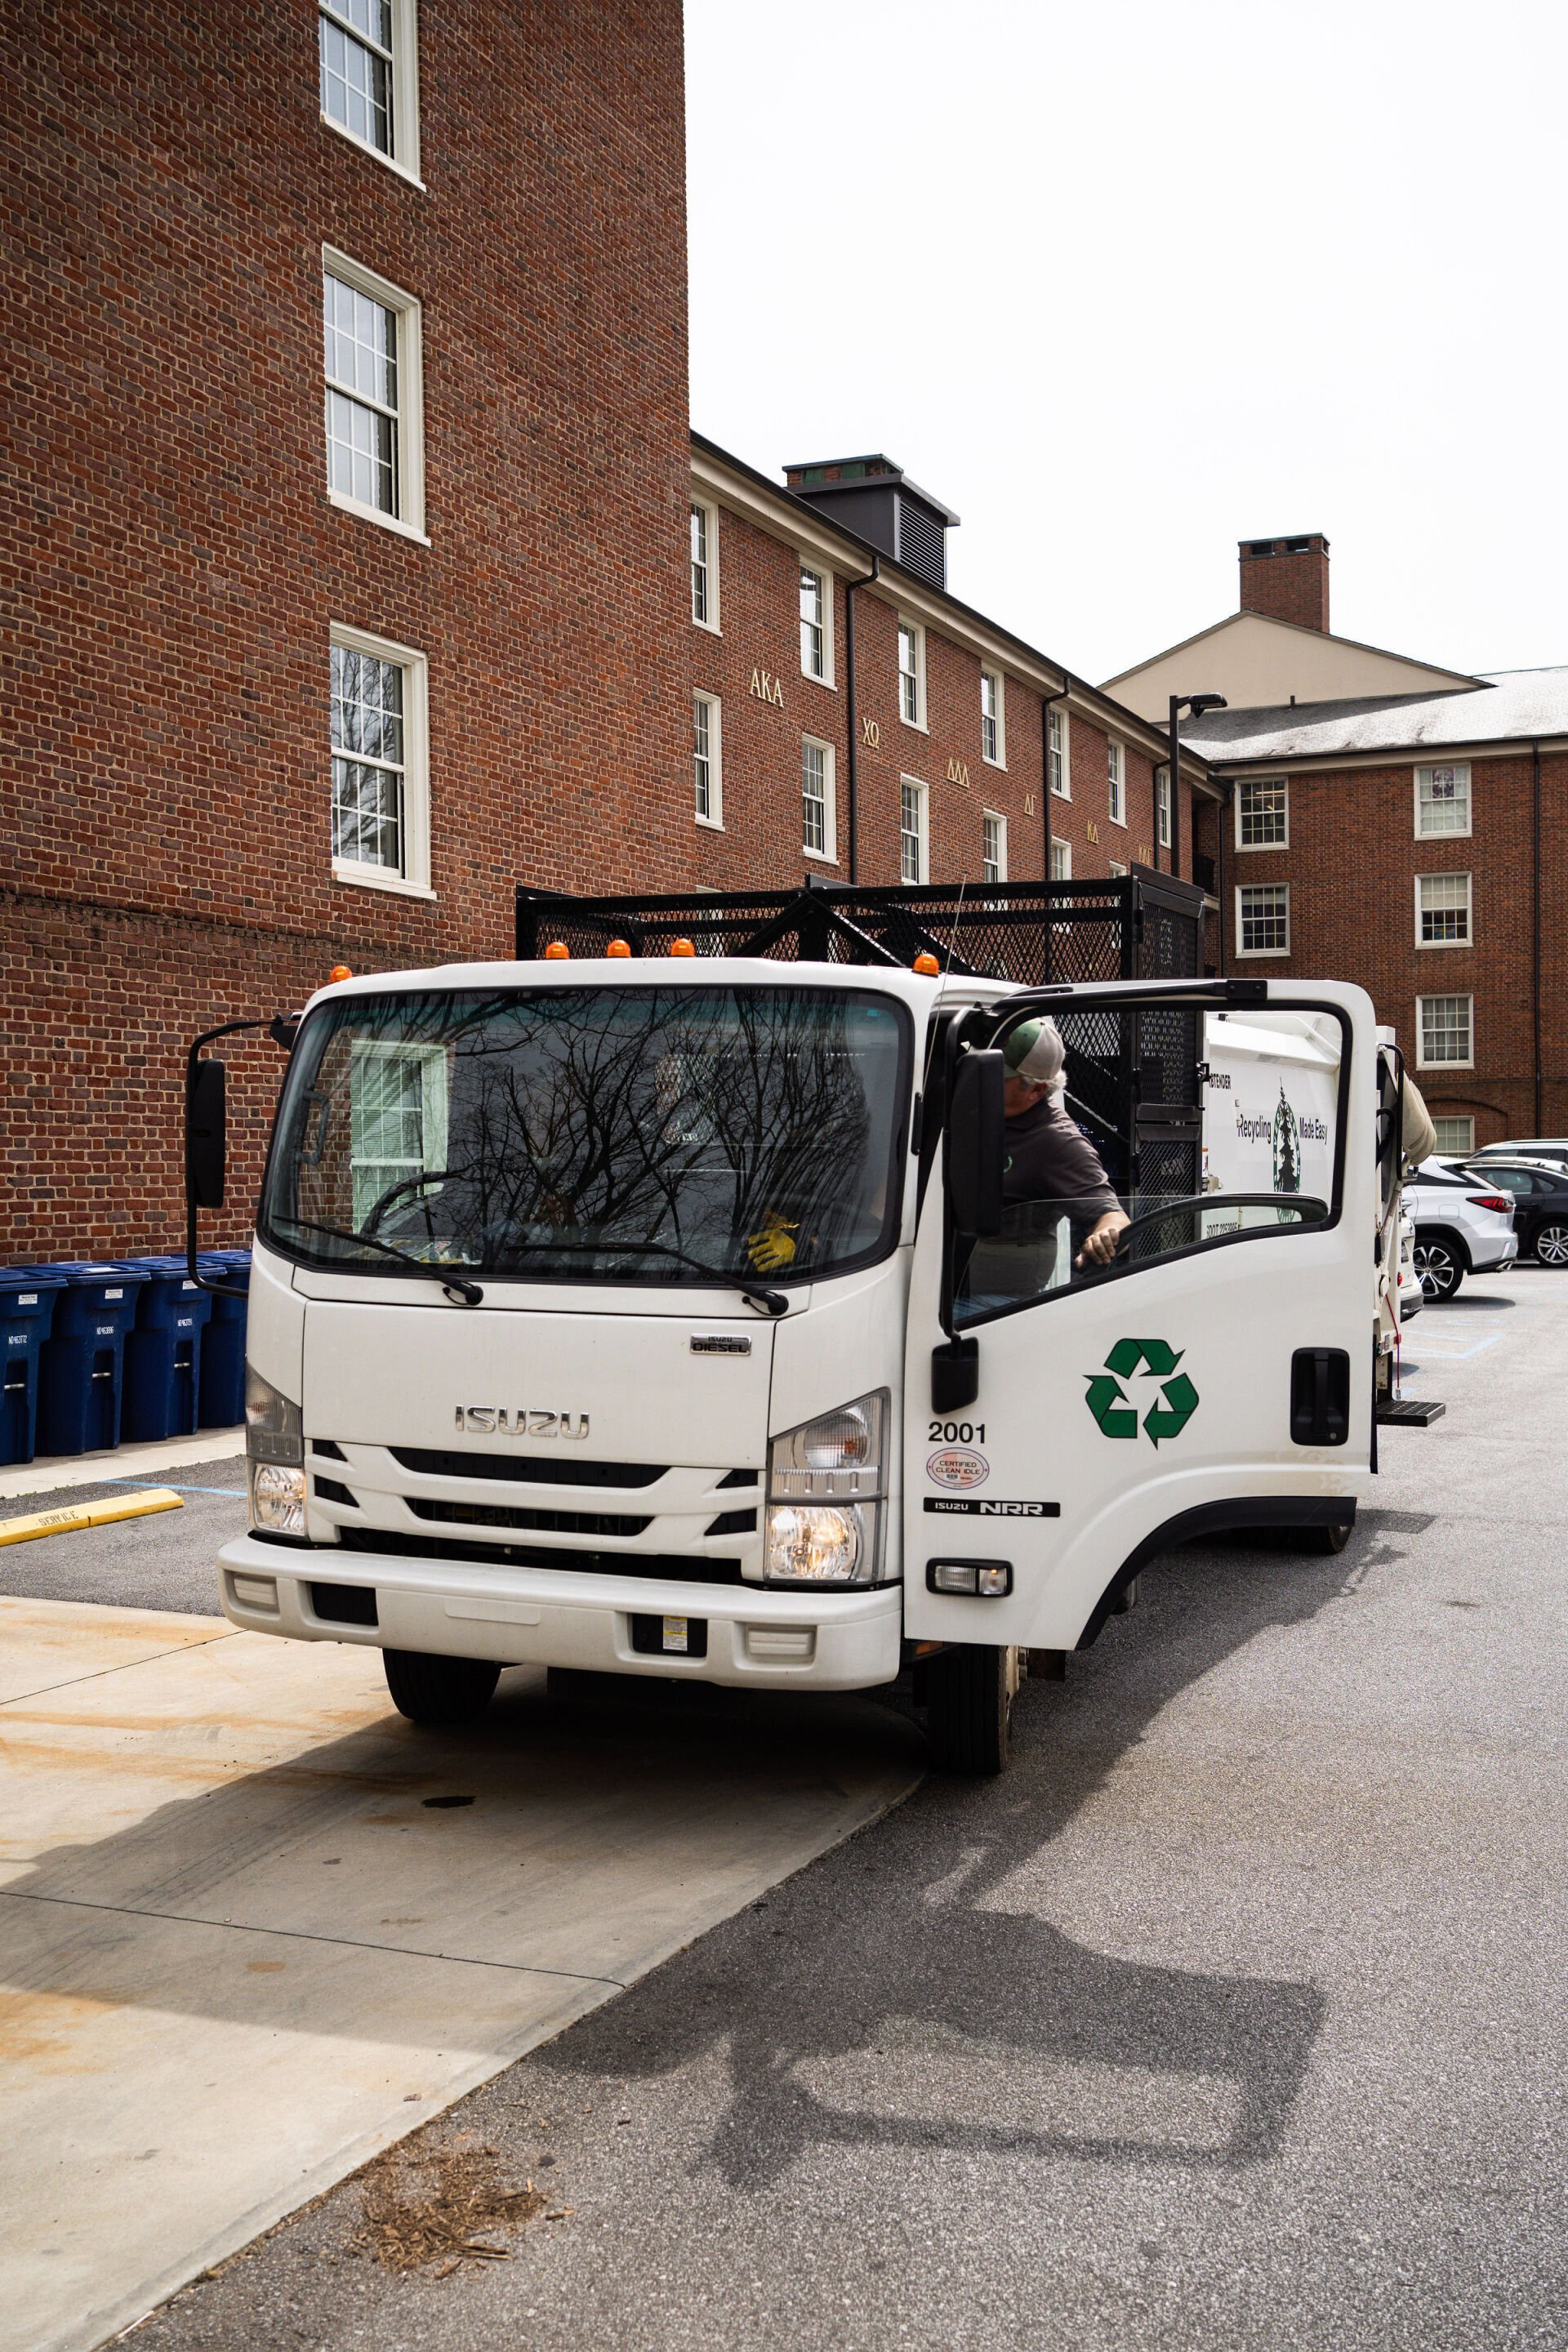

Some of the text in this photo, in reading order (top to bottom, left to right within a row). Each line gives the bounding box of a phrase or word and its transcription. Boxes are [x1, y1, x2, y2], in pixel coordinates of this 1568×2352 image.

[1237, 1114, 1328, 1145] Recycling Made Easy
[693, 1343, 747, 1353] DIESEL
[455, 1404, 590, 1439] ISUZU
[928, 1421, 986, 1444] 2001
[939, 1460, 977, 1468] CERTIFIED
[934, 1502, 1043, 1516] ISUZU NRR
